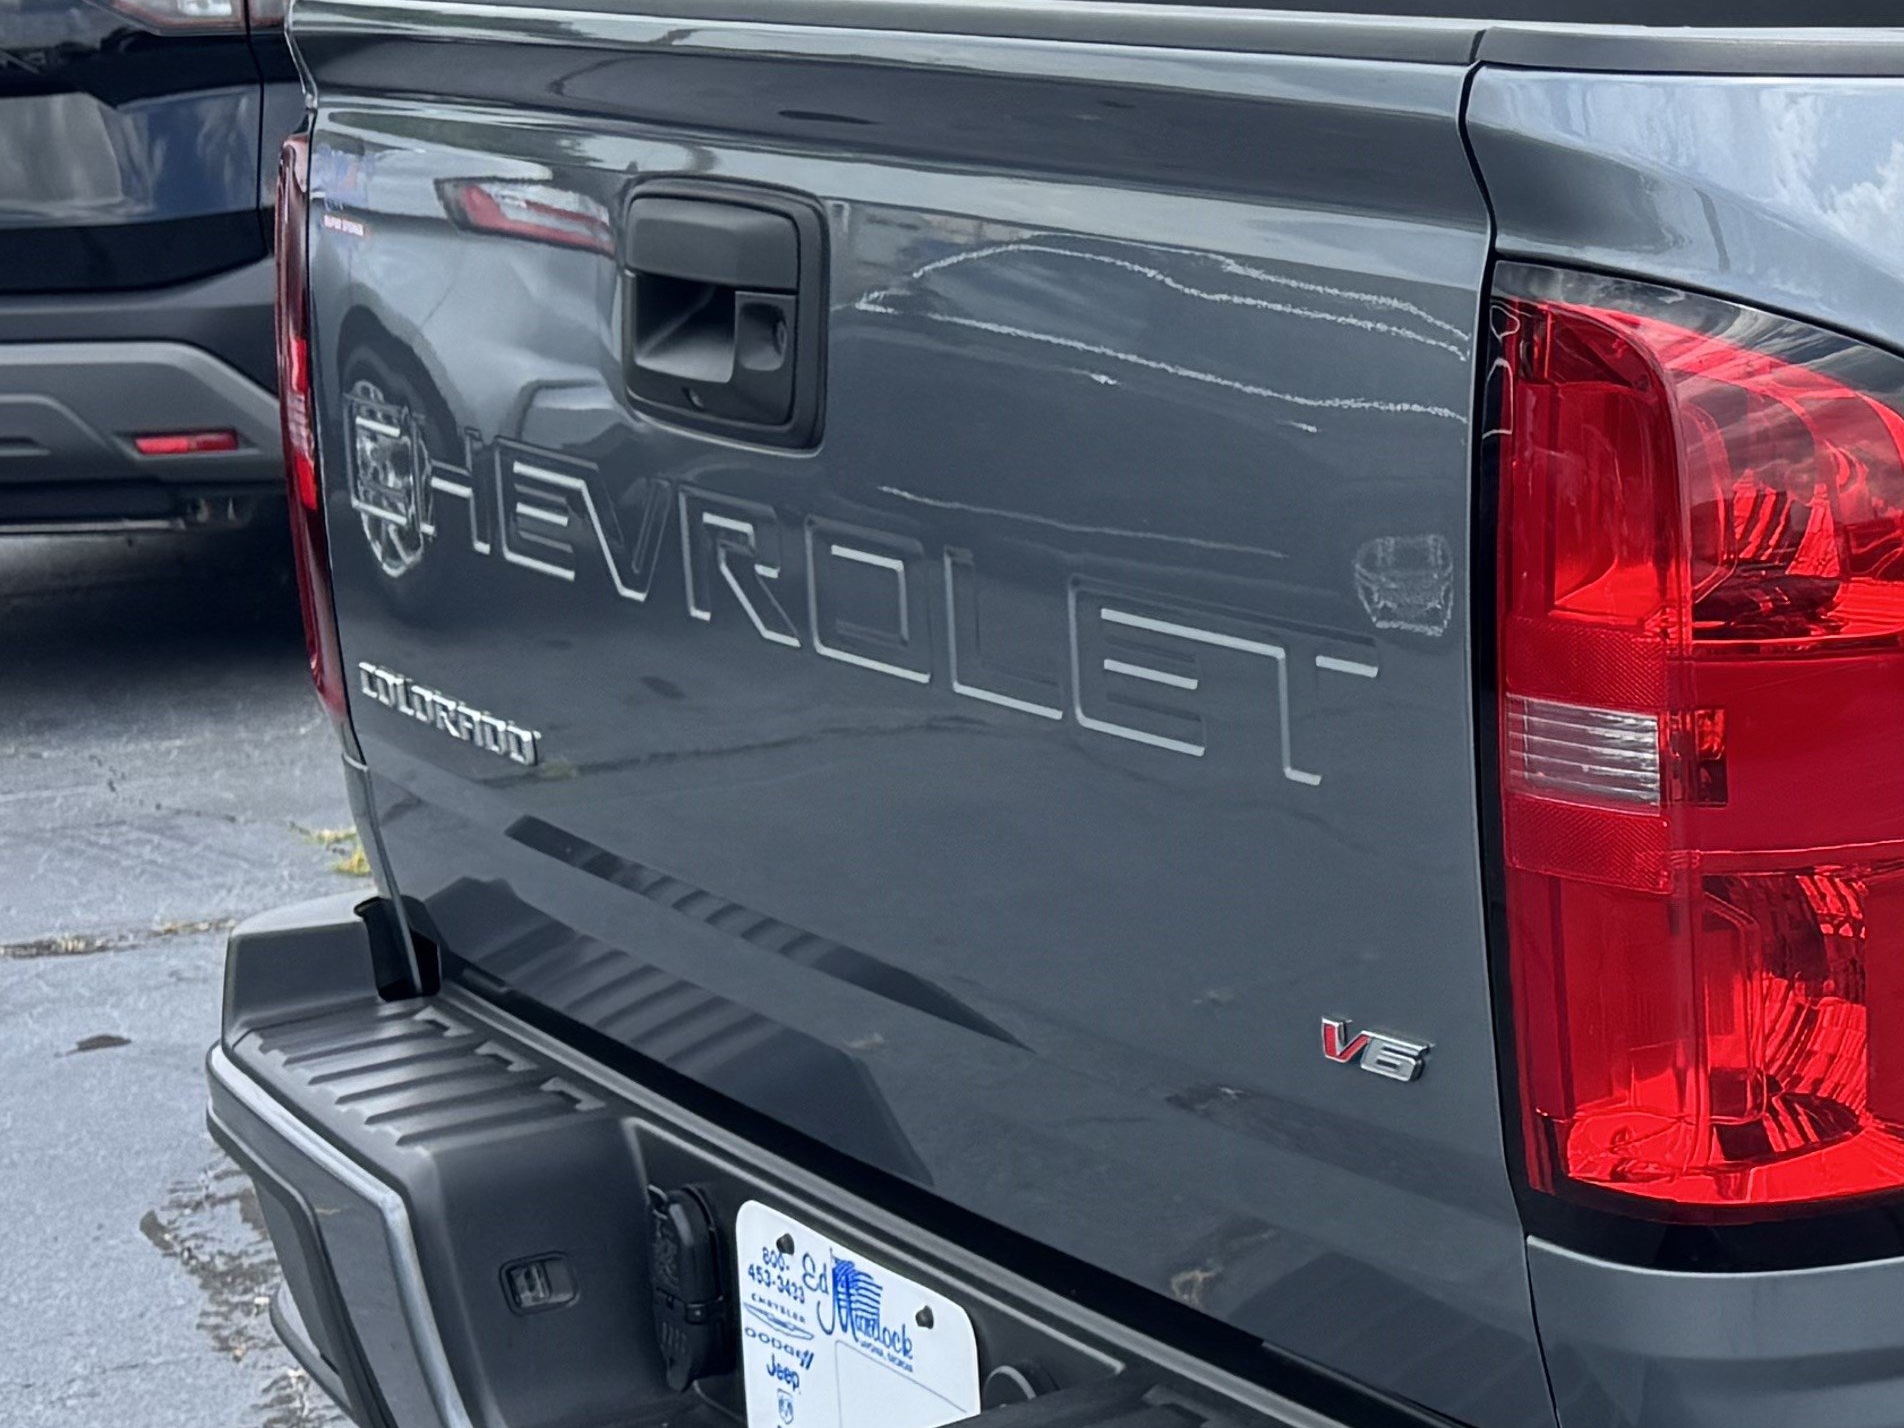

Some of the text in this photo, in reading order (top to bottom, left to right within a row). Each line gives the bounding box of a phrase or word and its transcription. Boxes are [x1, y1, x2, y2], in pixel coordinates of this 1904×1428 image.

[350, 390, 1380, 786] CHEVROLET
[358, 660, 537, 766] COLORADO
[1320, 1015, 1432, 1083] V6
[802, 1252, 829, 1295] Ed
[766, 1352, 801, 1392] Jeep
